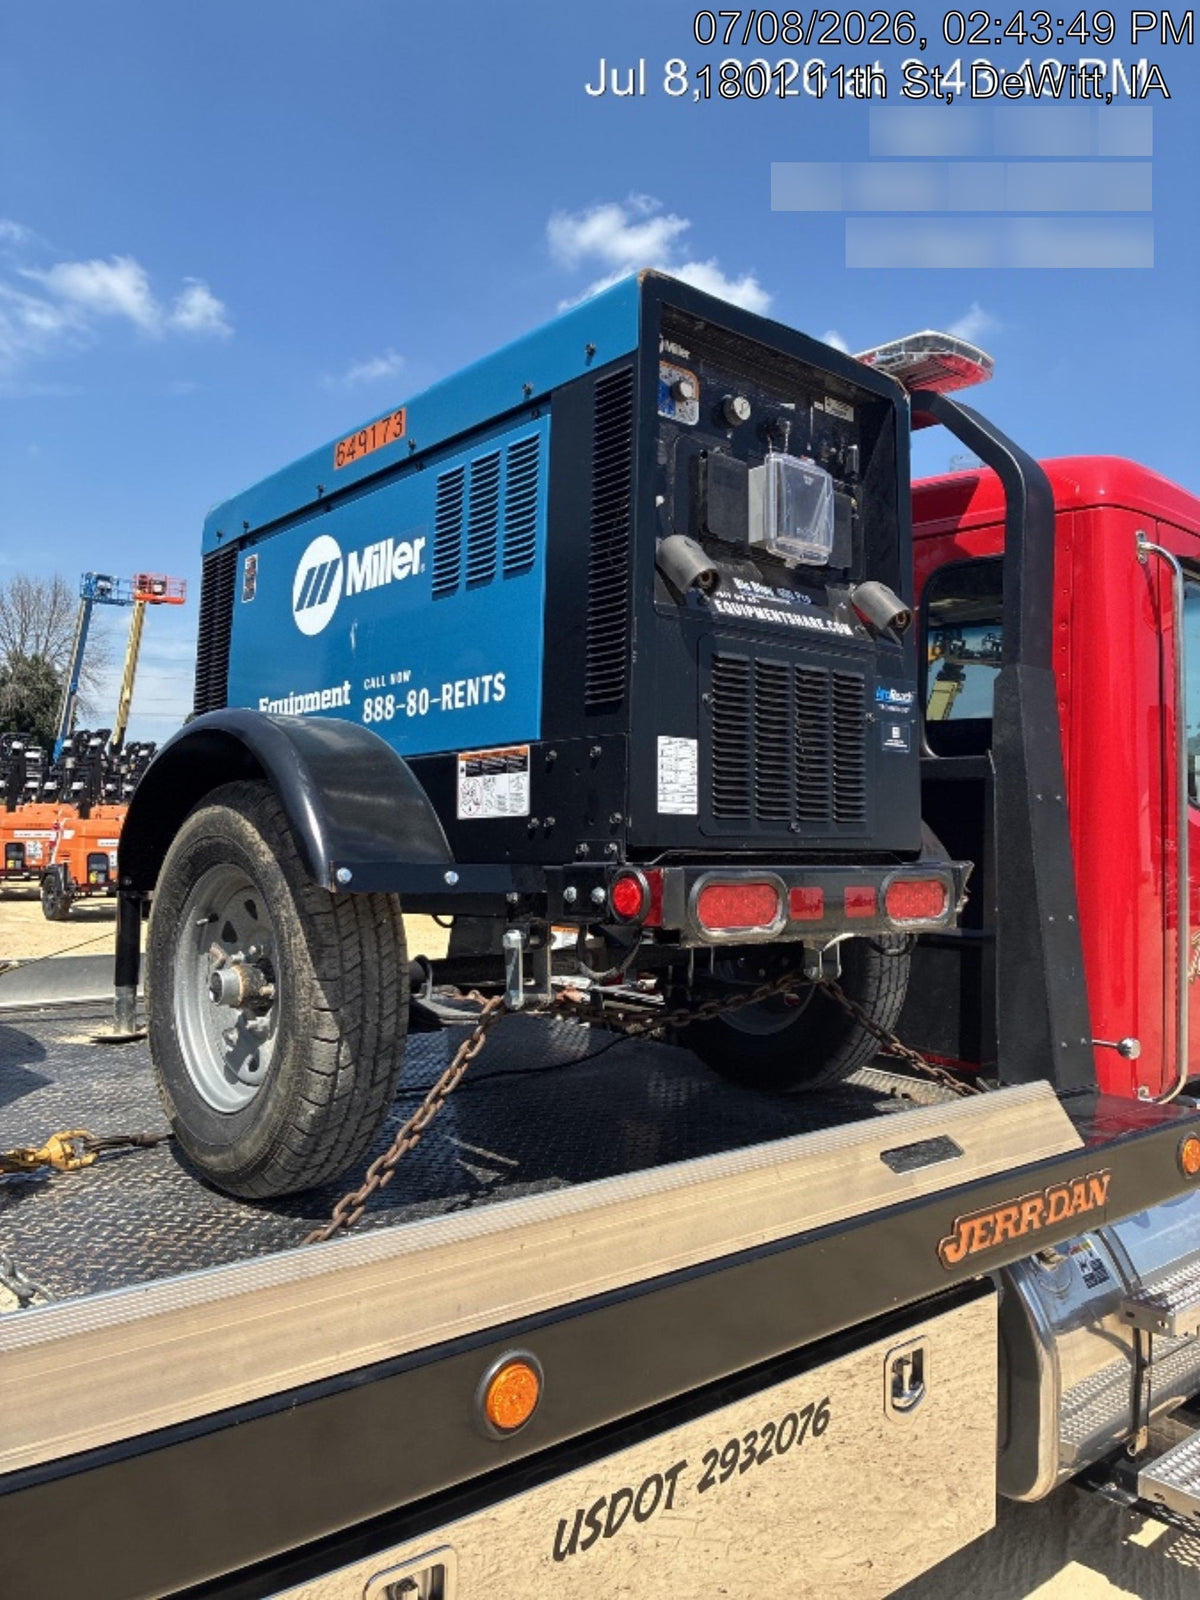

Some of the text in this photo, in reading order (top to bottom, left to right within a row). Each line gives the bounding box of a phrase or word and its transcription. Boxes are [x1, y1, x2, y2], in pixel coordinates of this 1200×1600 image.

[335, 409, 404, 467] 649173
[346, 536, 426, 597] Miller
[362, 671, 506, 723] 888-80-RENTS
[363, 670, 411, 690] CALL NOW
[552, 1396, 831, 1562] USDOT 2932076
